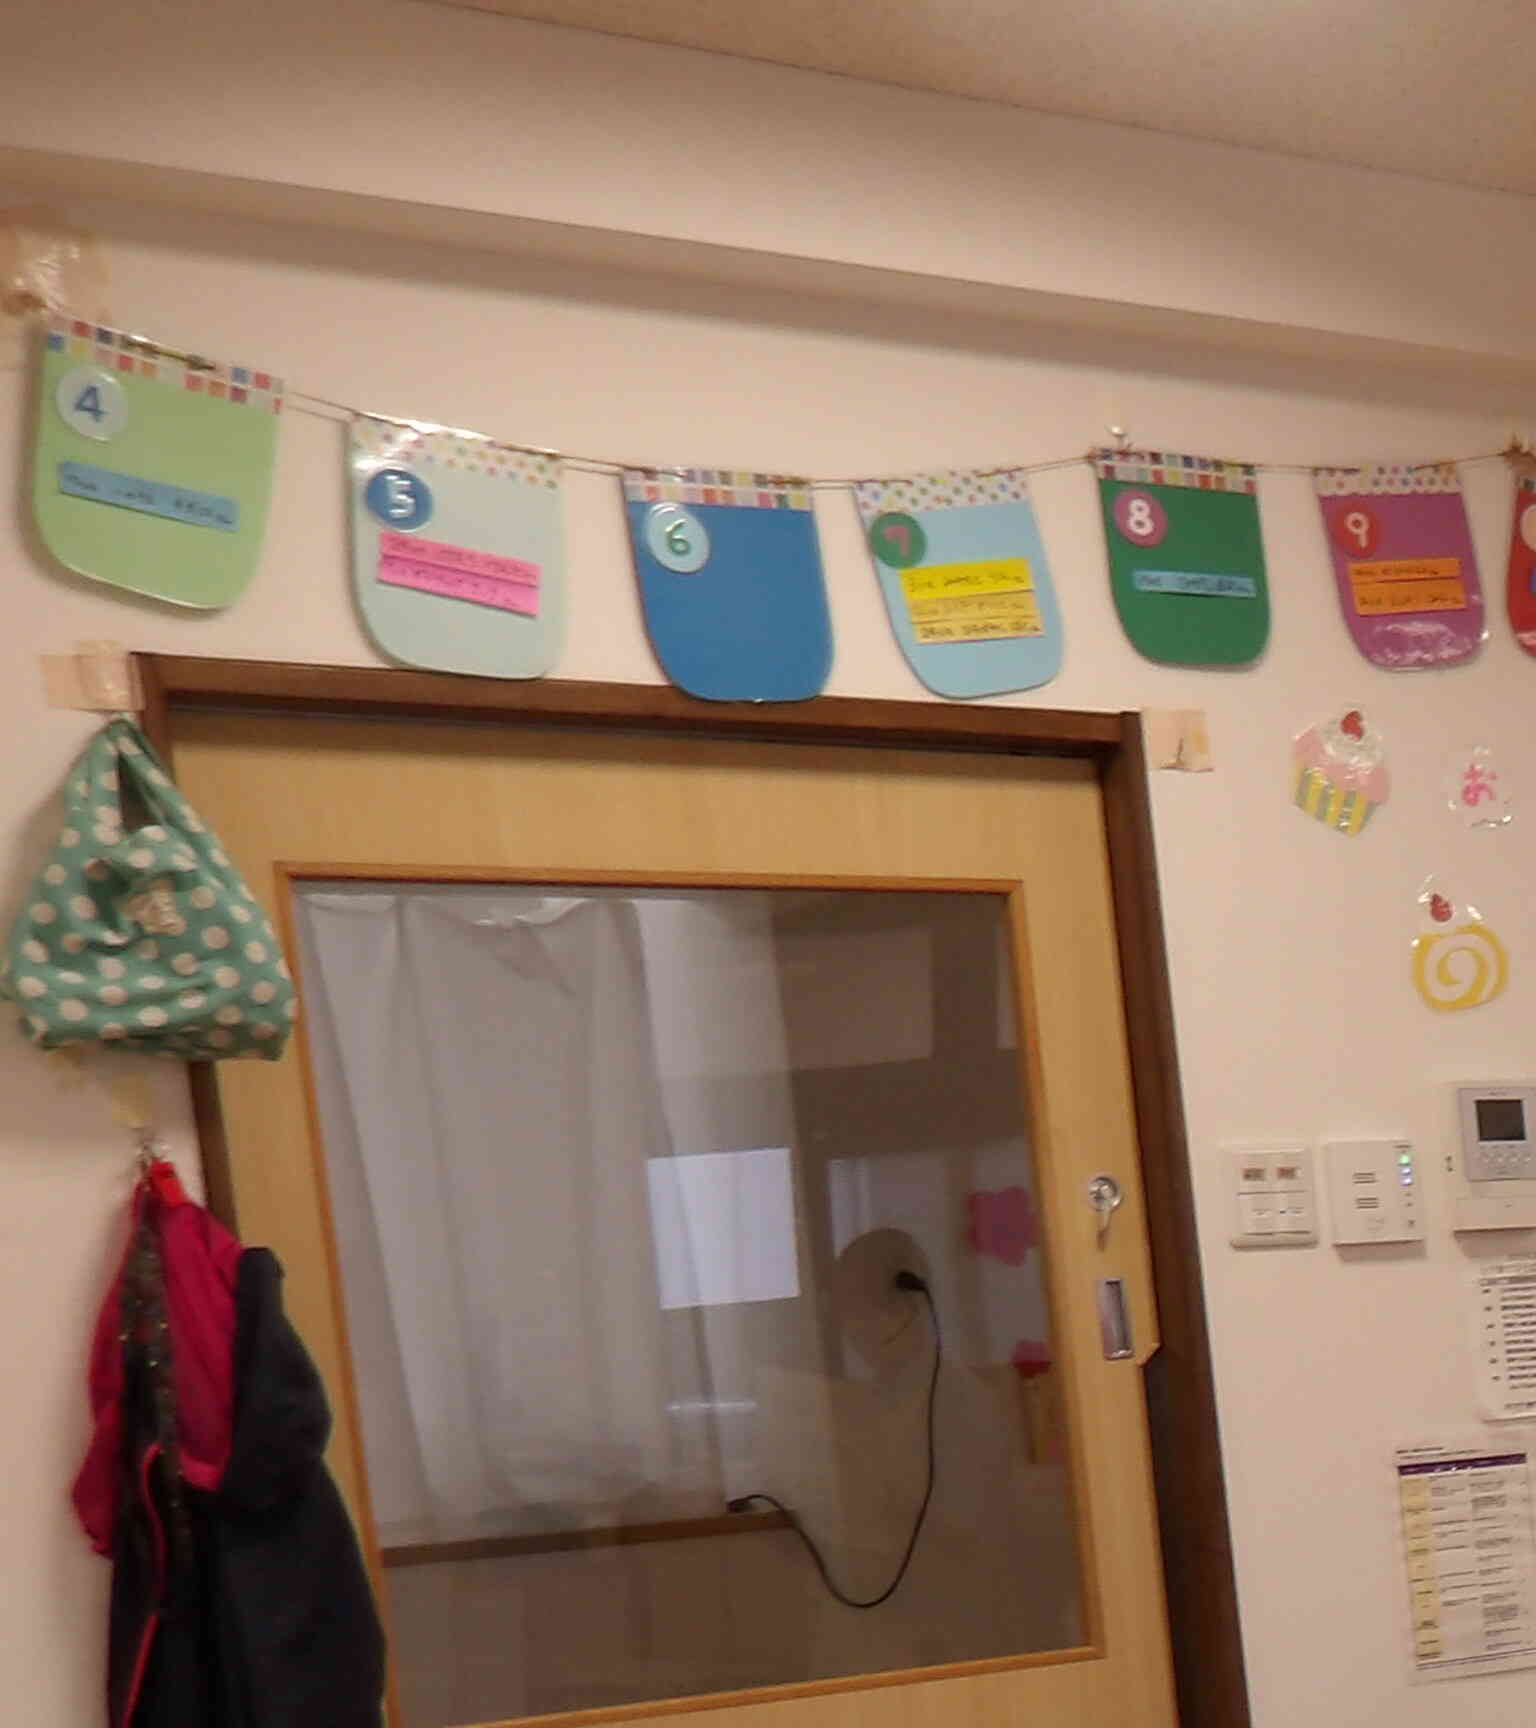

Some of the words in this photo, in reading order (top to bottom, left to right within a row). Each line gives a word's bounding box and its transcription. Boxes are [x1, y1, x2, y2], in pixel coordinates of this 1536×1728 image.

[73, 384, 108, 423] 4
[385, 475, 418, 519] 5
[1127, 498, 1155, 536] 8
[1346, 510, 1371, 549] 9
[664, 519, 692, 556] 6
